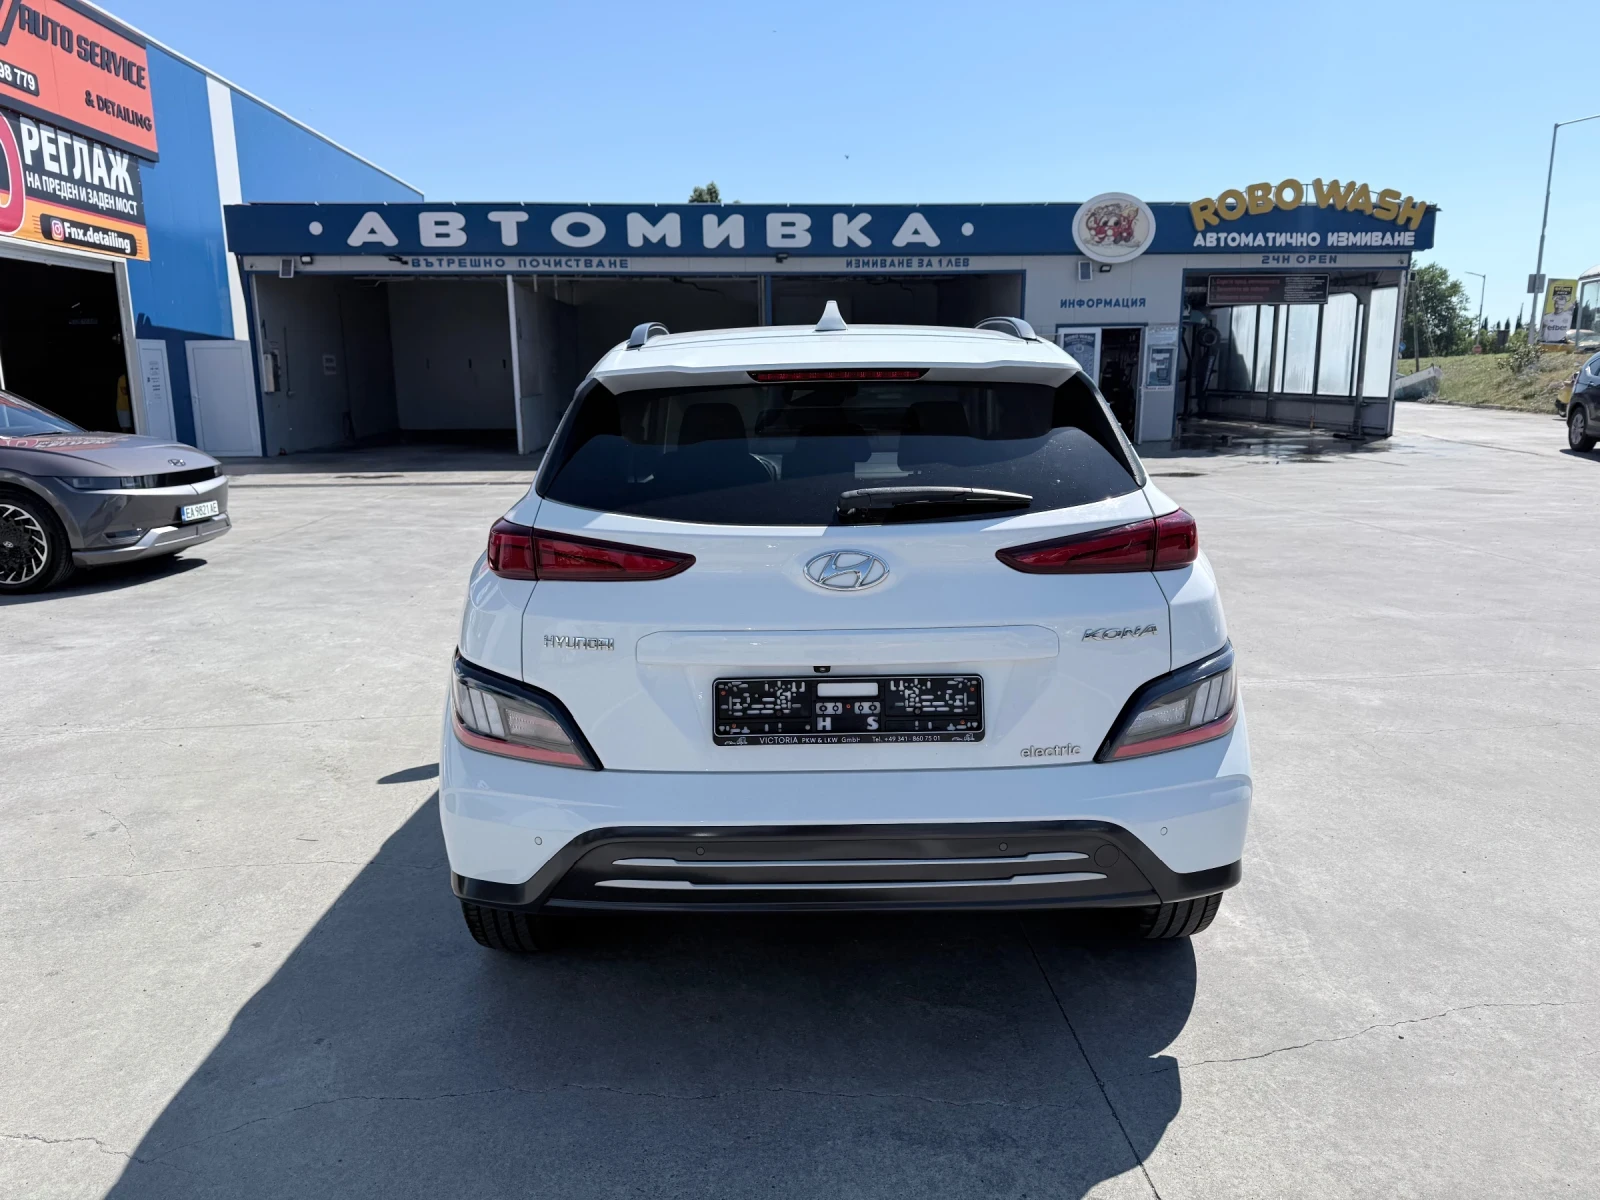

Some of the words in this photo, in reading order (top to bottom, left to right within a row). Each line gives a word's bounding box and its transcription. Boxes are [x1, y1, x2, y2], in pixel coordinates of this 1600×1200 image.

[19, 3, 73, 54] AUTO
[76, 34, 147, 90] SERVICE
[13, 68, 36, 91] 779
[84, 90, 95, 109] &
[96, 94, 153, 132] DETAILING
[19, 116, 135, 196] РЕГЛАЖ
[25, 171, 42, 191] НА
[42, 175, 79, 200] ПРЕДЕН
[79, 186, 88, 202] И
[87, 188, 115, 211] ЗАДЕН
[115, 196, 138, 216] МОСТ
[1189, 178, 1304, 232] ROBO
[1312, 177, 1427, 231] WASH
[63, 221, 132, 254] Fnx.detailing
[347, 210, 941, 249] АВТОМИВКА
[1193, 231, 1321, 248] АВТОМАТИЧНО
[1326, 231, 1416, 247] ИЗМИВАНЕ
[411, 257, 506, 269] ВЪТРЕШНО
[518, 257, 629, 270] ПОЧИСТВАНЕ
[845, 257, 914, 269] ИЗМИВАНЕ
[917, 257, 934, 269] ЗА
[946, 257, 970, 268] ЛЕВ
[1261, 254, 1291, 266] 24H
[1296, 254, 1338, 265] OPEN
[1060, 298, 1146, 308] ИНФОРМАЦИЯ
[185, 507, 195, 518] EA
[210, 502, 217, 513] AE
[1081, 623, 1158, 642] KONA
[543, 634, 615, 651] HYUNDAI
[816, 717, 832, 731] H
[866, 717, 879, 731] S
[759, 737, 799, 745] VICTORIA
[1020, 743, 1081, 758] electric
